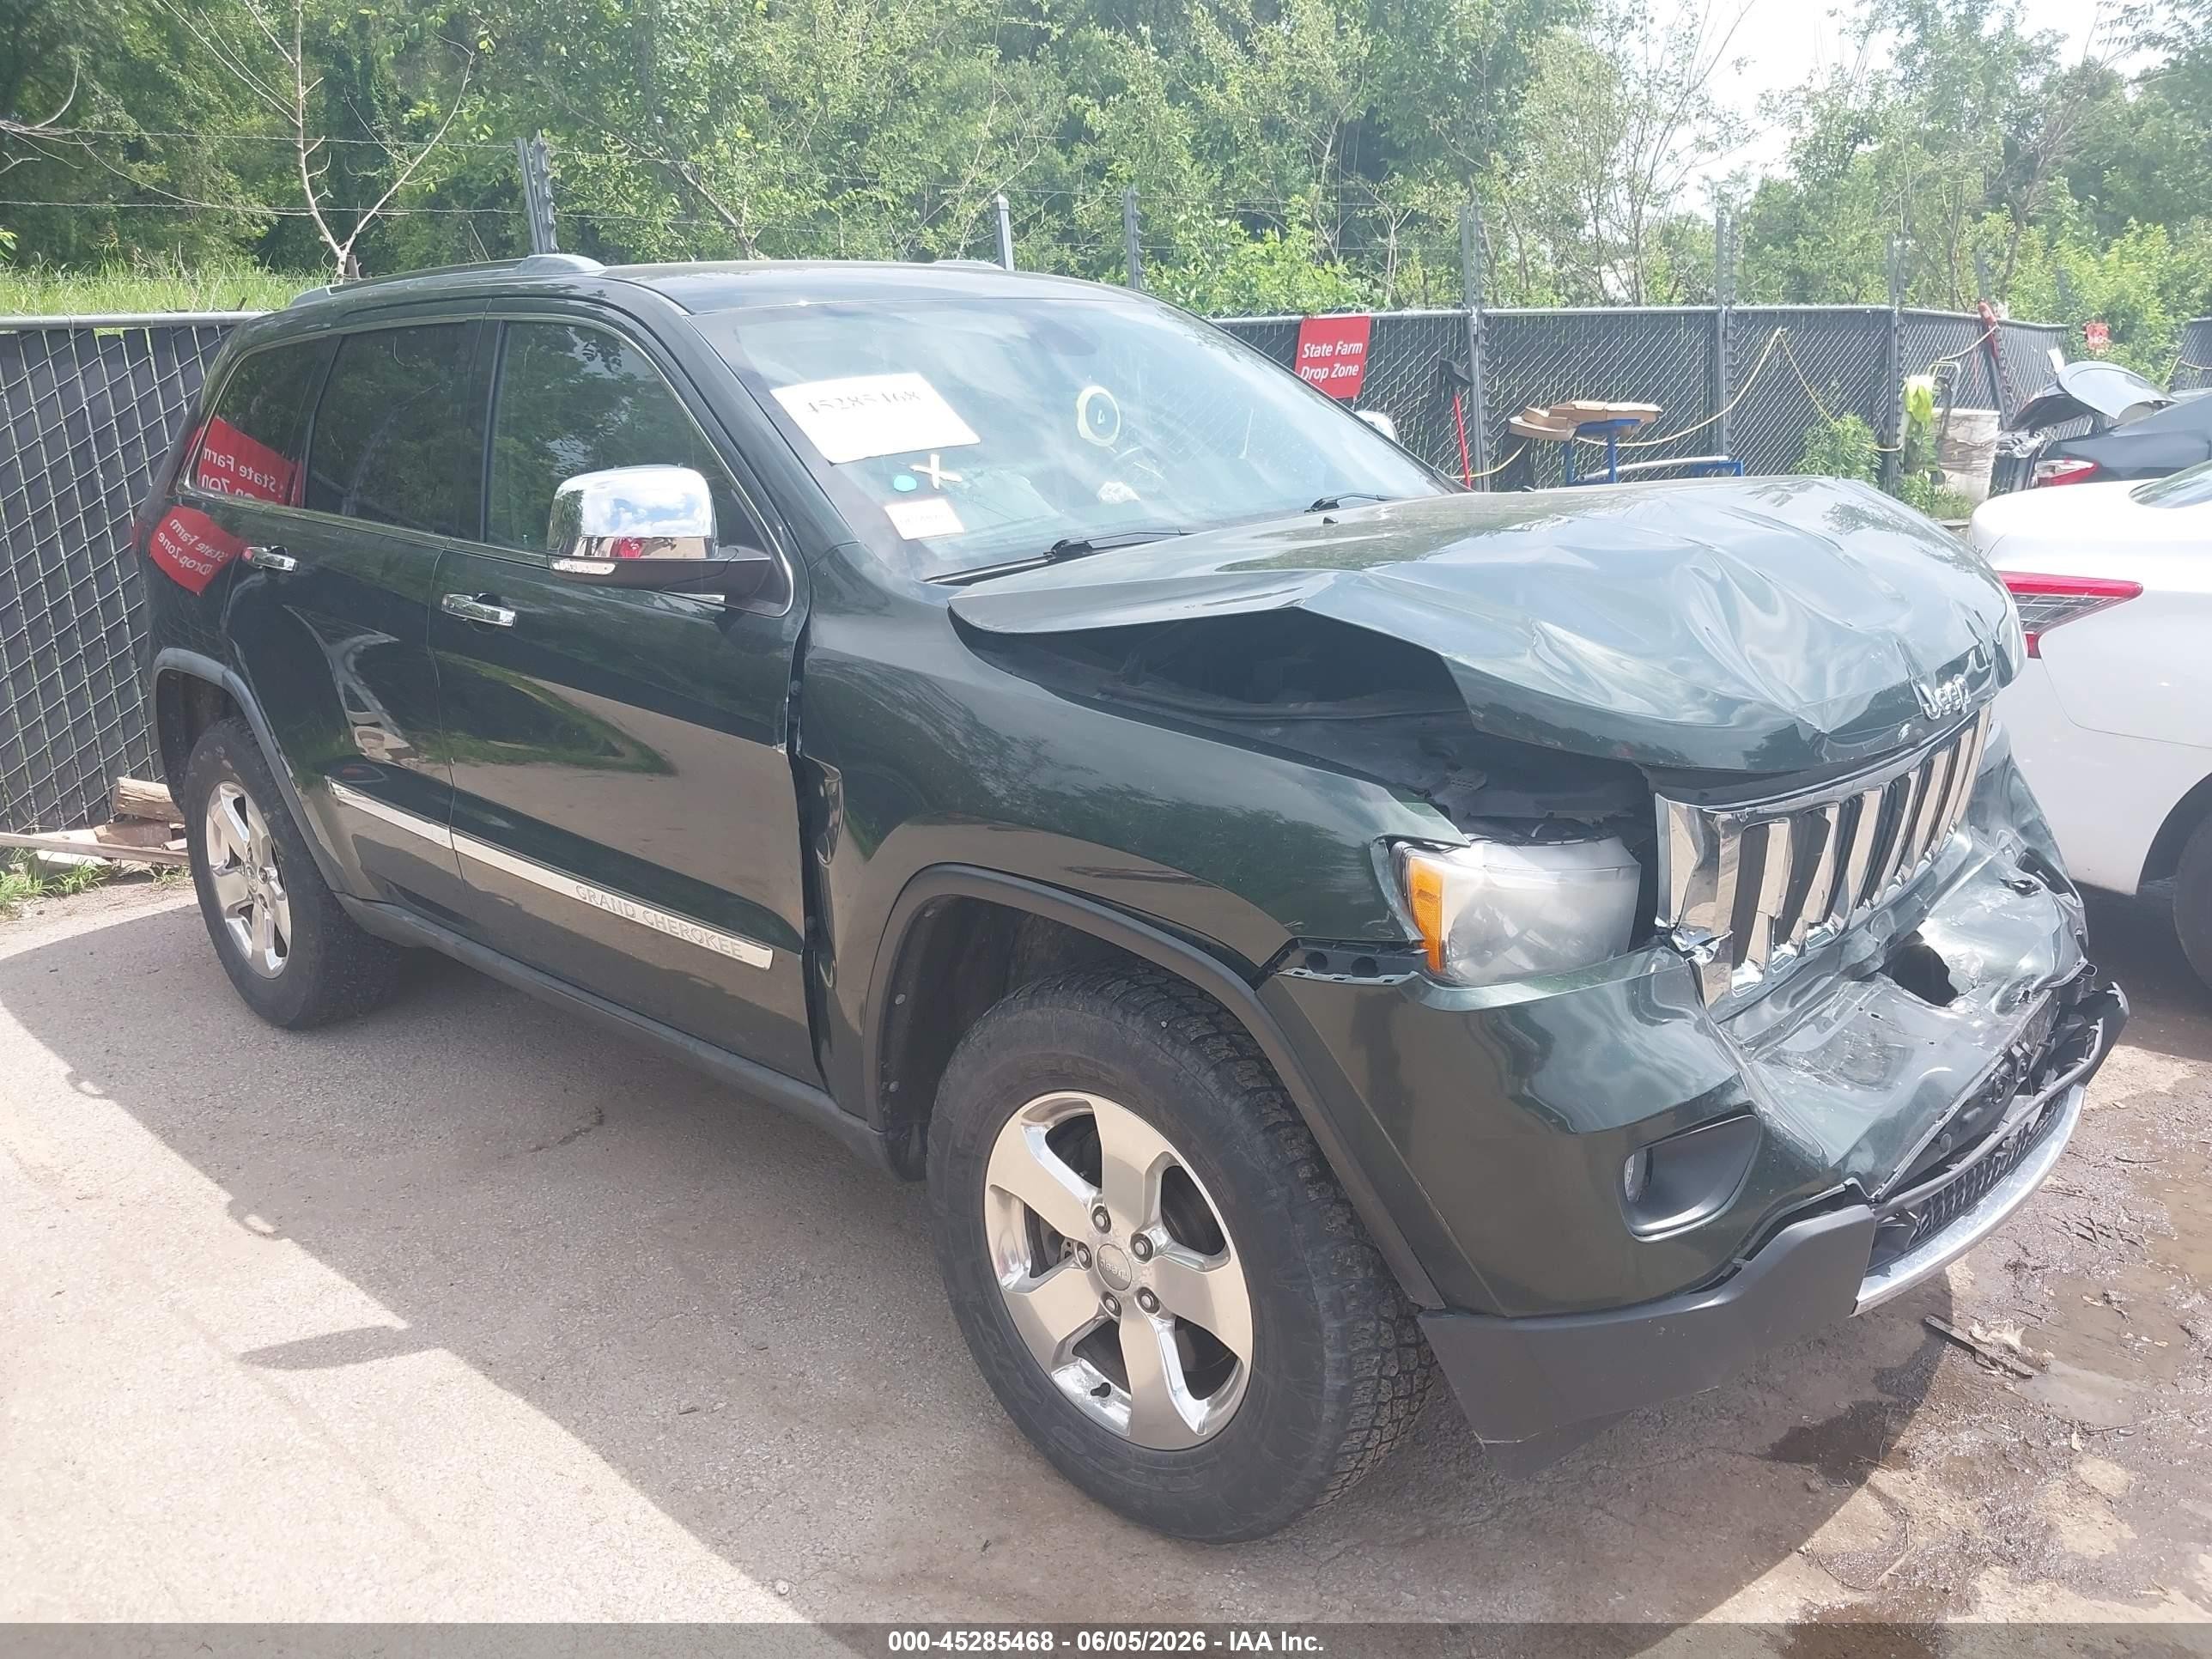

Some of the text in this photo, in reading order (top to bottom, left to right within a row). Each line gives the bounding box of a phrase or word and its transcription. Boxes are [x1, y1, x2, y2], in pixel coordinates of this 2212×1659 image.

[1302, 340, 1364, 359] State Farm
[1300, 363, 1359, 384] Drop Zone
[1919, 674, 1972, 720] Jeep
[574, 884, 744, 959] GRAND CHEROKEE
